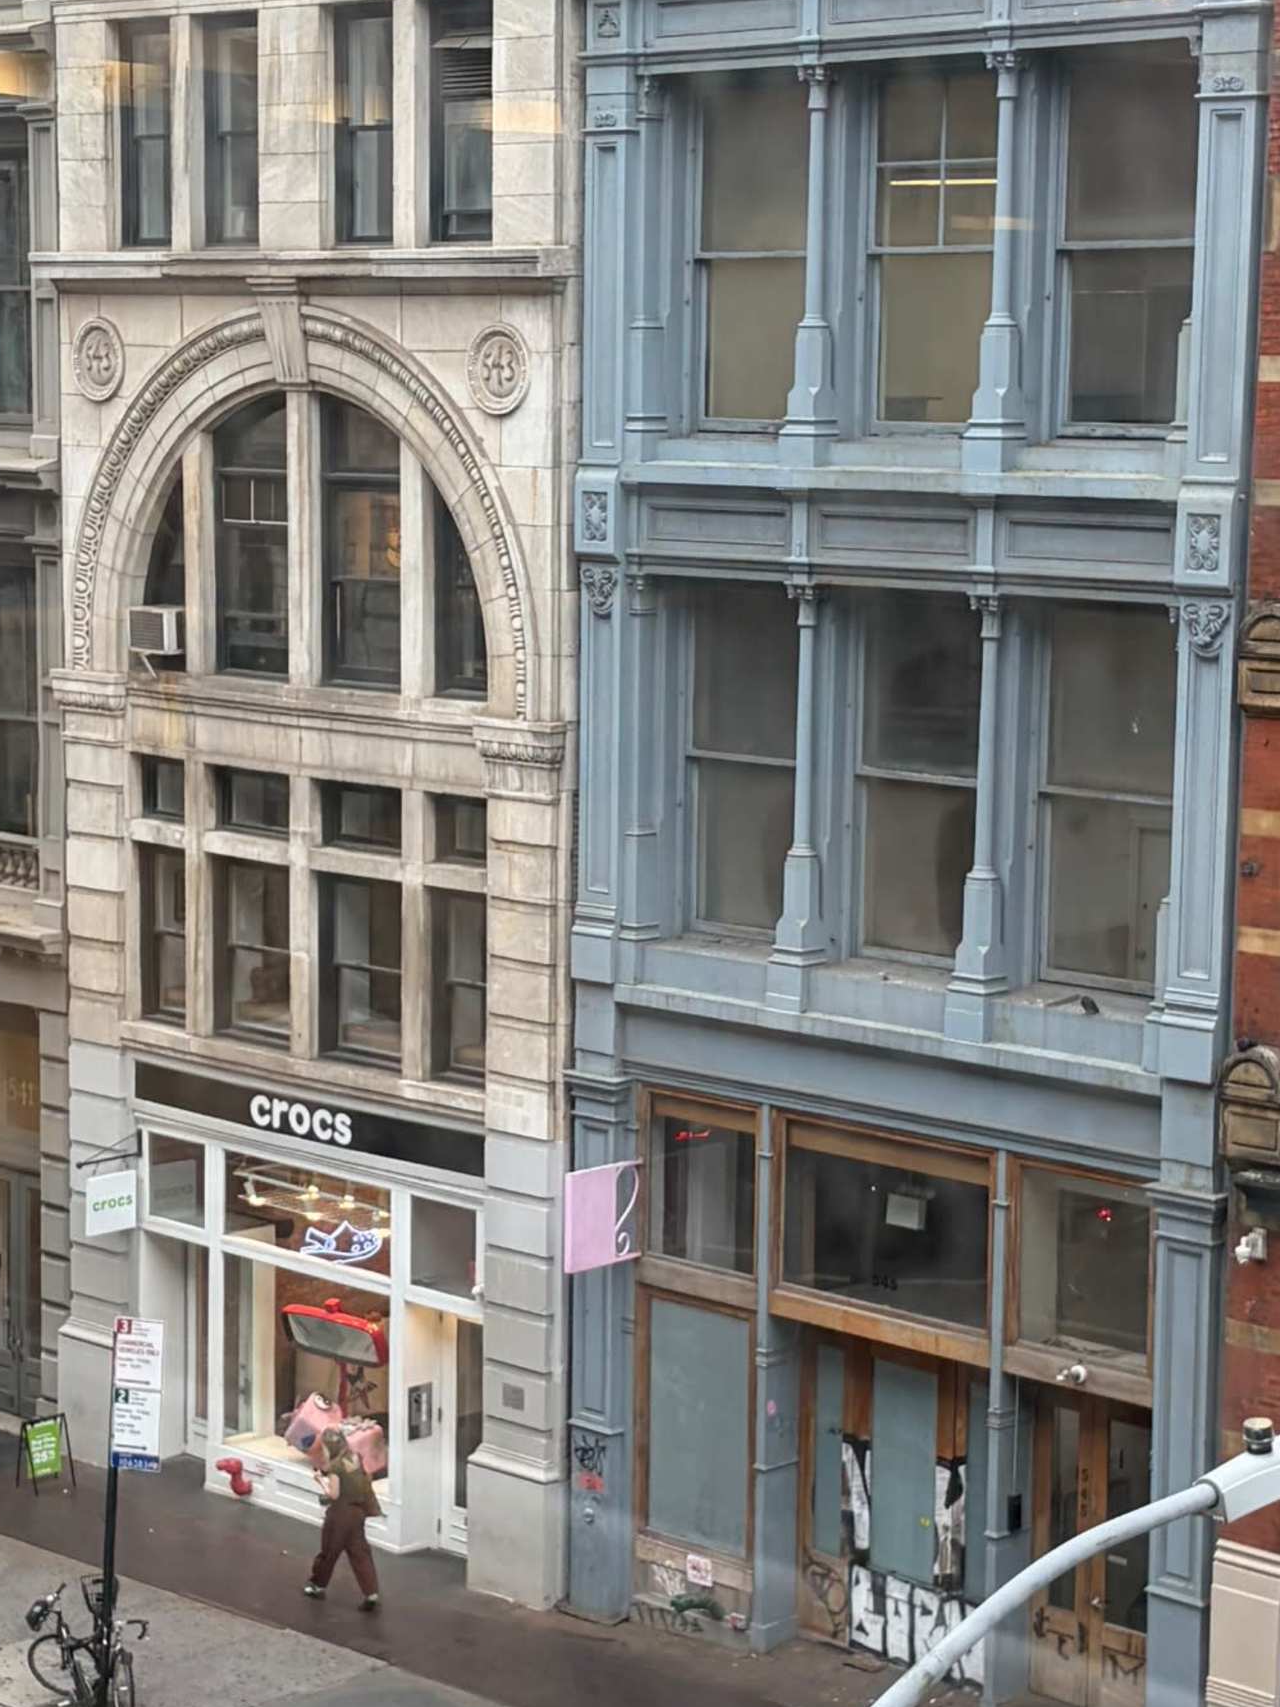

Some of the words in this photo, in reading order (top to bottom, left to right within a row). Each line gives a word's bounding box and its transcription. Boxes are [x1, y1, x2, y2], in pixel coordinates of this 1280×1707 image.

[86, 339, 112, 374] 543
[483, 345, 515, 387] 543
[250, 1094, 352, 1145] crocs
[92, 1194, 133, 1212] crocs
